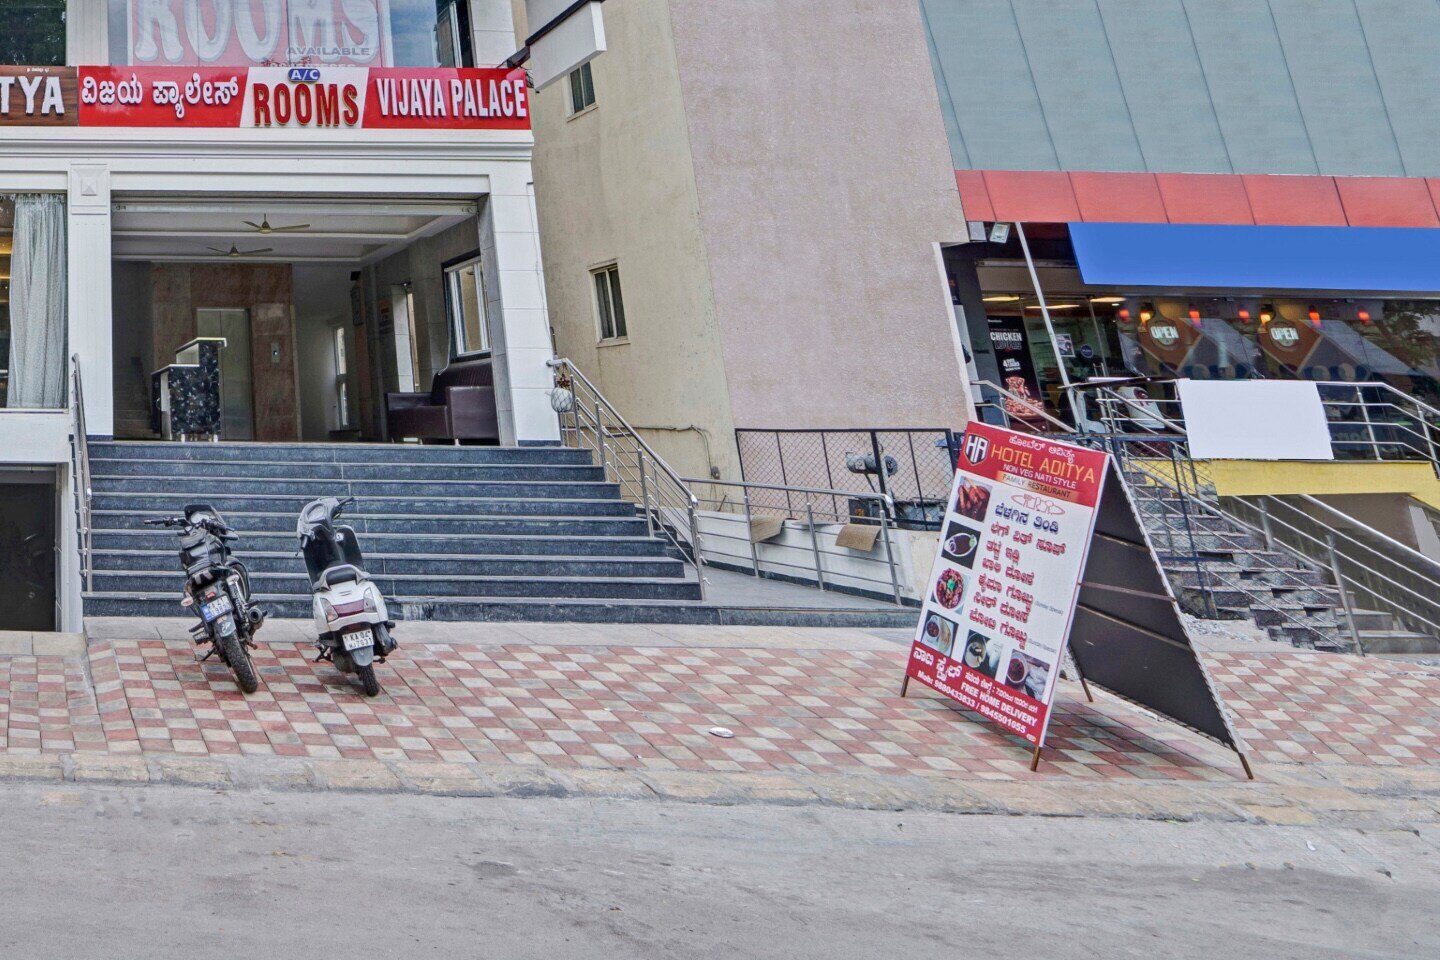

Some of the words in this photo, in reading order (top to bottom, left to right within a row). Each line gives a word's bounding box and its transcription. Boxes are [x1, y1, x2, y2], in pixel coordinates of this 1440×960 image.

[286, 46, 371, 56] AVAILABLE
[291, 69, 319, 81] A/C
[81, 73, 143, 104] ವಿಜಯ
[152, 73, 238, 118] ಪ್ಯಾಲೇಸ್
[253, 82, 359, 126] ROOMS
[376, 78, 446, 117] VIJAYA
[450, 79, 527, 117] PALACE
[990, 331, 1022, 341] CHICKEN
[1150, 325, 1179, 340] OPEN
[1270, 325, 1300, 340] OPEN
[963, 434, 989, 464] HA
[990, 443, 1036, 468] HOTEL
[1039, 456, 1096, 485] ADITYA
[1002, 464, 1018, 473] NON
[1019, 468, 1033, 477] VEG
[1034, 472, 1051, 482] NATI
[1052, 476, 1076, 489] STYLE
[1002, 473, 1025, 485] FAMILY
[1027, 479, 1070, 498] RESTAURANT
[960, 681, 979, 697] FREE
[979, 691, 1000, 708] HOME
[1000, 701, 1037, 727] DELIVERY
